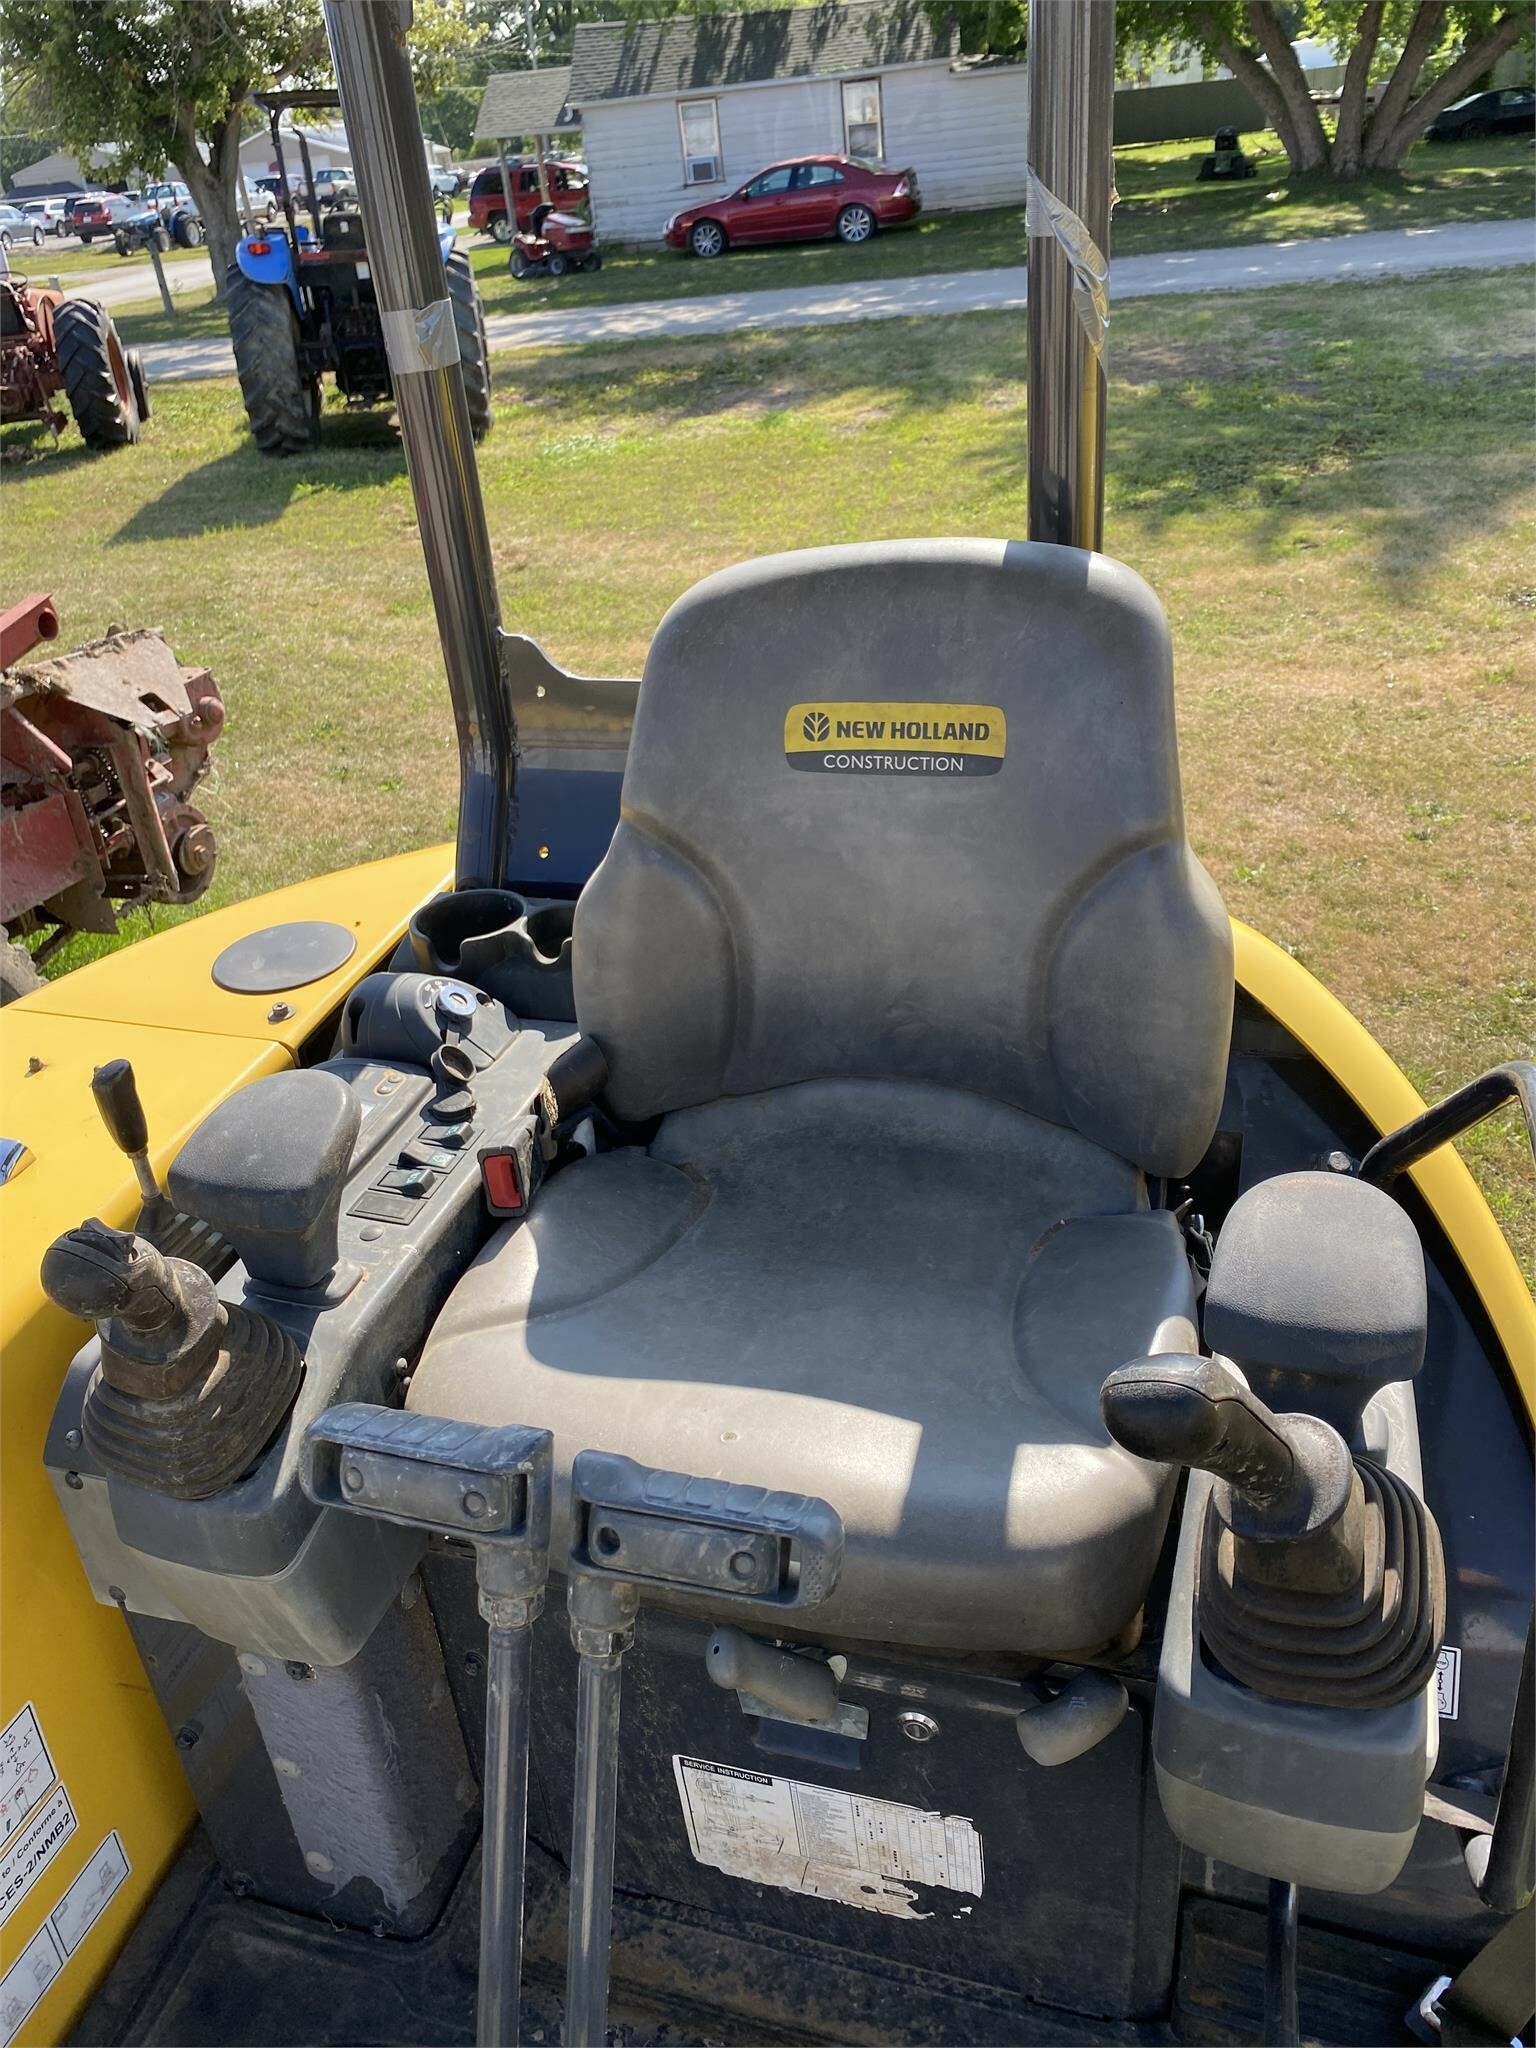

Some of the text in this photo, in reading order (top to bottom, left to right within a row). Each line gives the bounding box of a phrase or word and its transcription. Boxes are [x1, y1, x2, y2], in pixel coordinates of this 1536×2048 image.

[836, 720, 990, 741] NEW HOLLAND
[823, 754, 964, 772] CONSTRUCTION
[683, 1759, 768, 1784] SERVICE INSTRUCTION
[1, 1866, 11, 1879] to
[16, 1807, 57, 1859] Conforme
[57, 1798, 63, 1808] à
